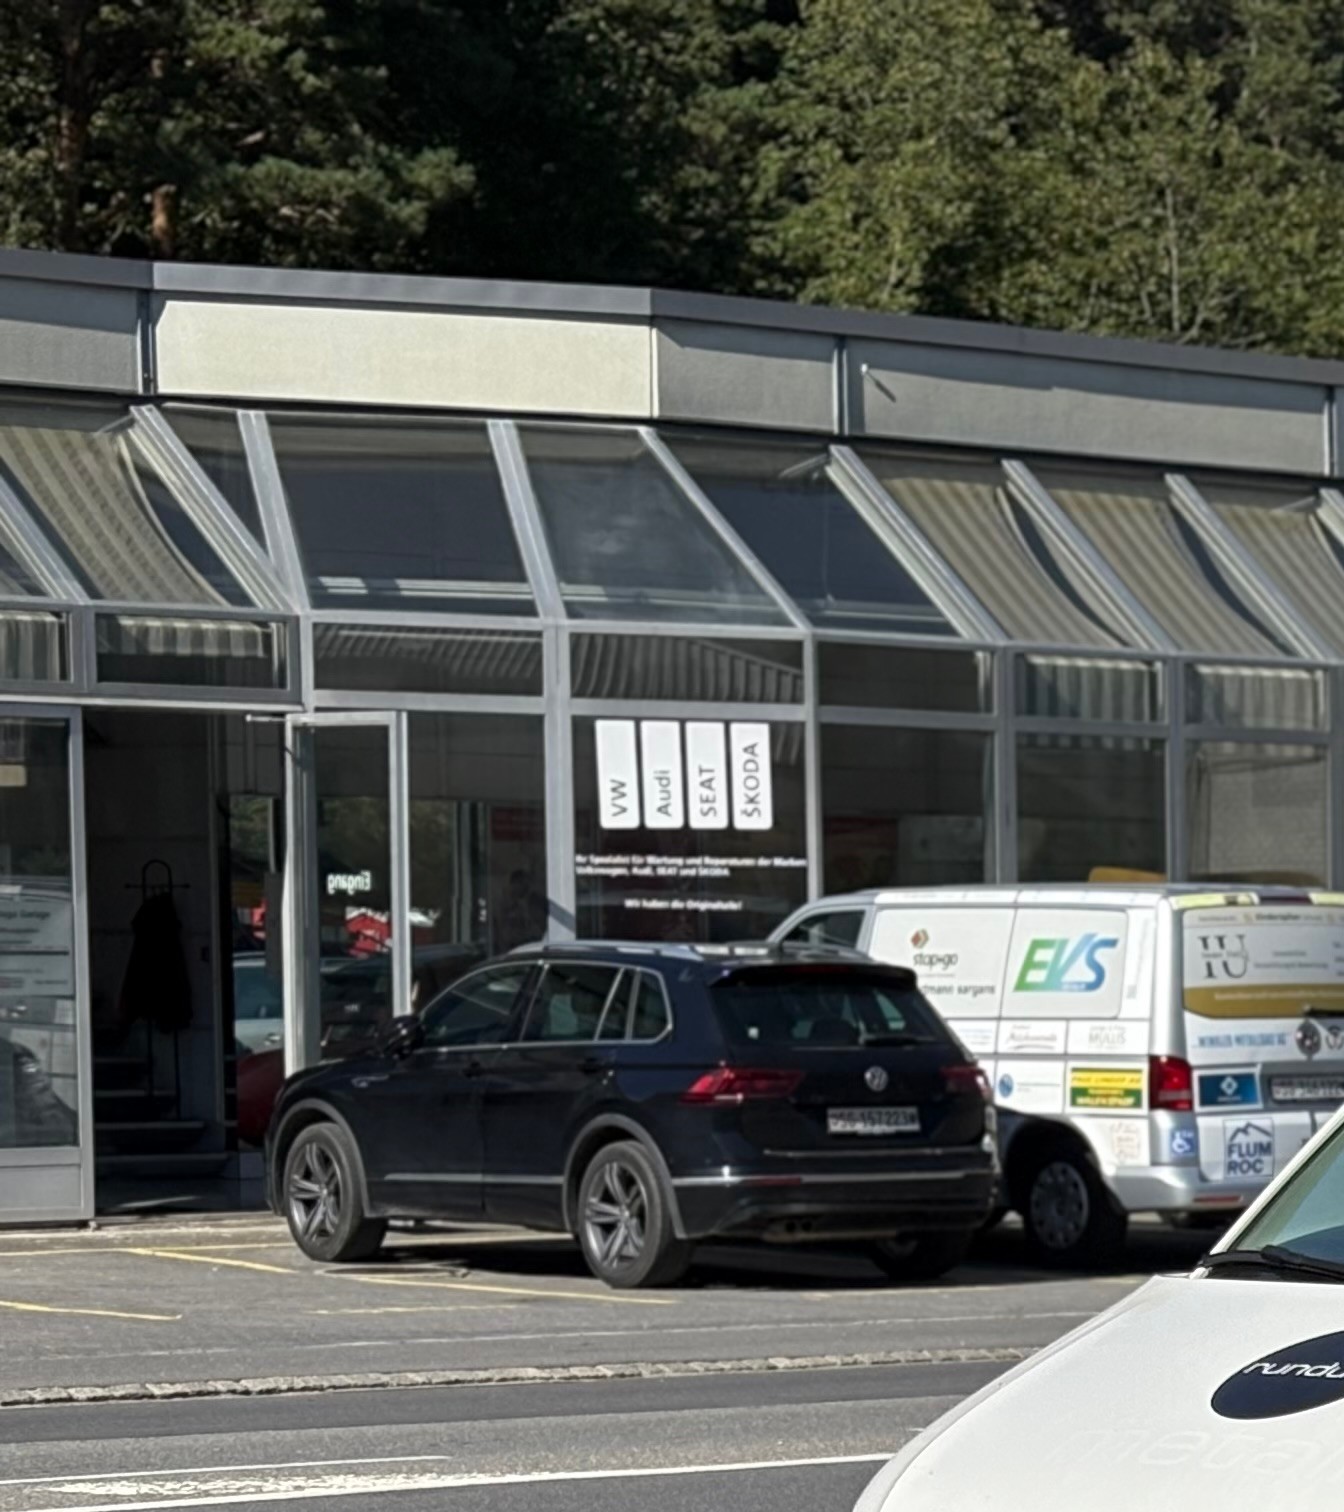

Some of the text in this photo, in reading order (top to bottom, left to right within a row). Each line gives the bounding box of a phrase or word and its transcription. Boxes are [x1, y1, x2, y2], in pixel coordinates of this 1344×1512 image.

[653, 769, 672, 818] Audi
[698, 765, 718, 818] SEAT
[740, 742, 762, 818] ŠKODA
[609, 778, 629, 818] VW
[589, 855, 630, 866] Spezialist
[631, 855, 645, 865] für
[646, 855, 683, 867] Wartung
[685, 856, 701, 866] und
[757, 858, 771, 867] der
[656, 867, 678, 877] SEAT
[680, 867, 697, 877] und
[642, 898, 669, 910] haben
[670, 900, 684, 910] die
[1012, 932, 1119, 992] EVS
[1226, 1141, 1273, 1158] FLUM
[1226, 1158, 1265, 1176] ROC
